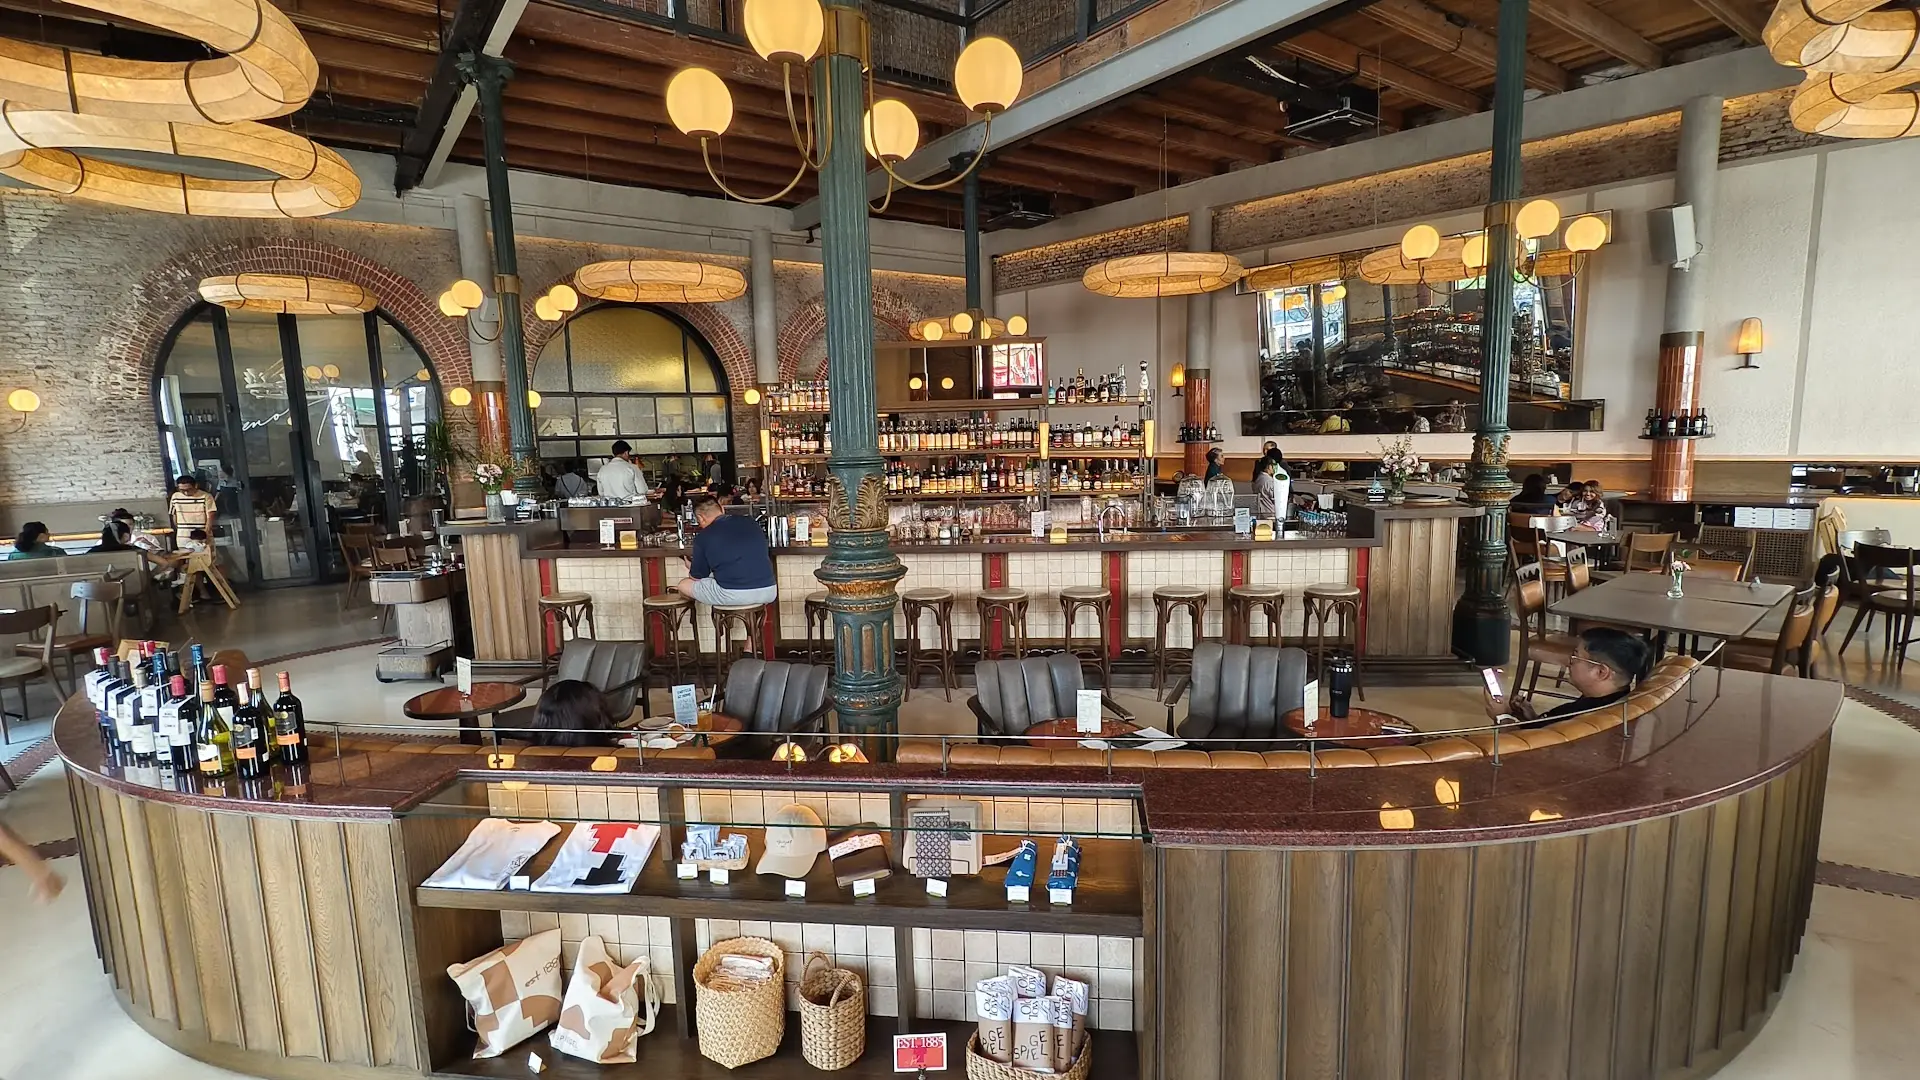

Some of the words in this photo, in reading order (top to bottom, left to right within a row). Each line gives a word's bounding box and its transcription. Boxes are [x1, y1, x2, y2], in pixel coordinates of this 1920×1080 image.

[542, 955, 559, 974] 188
[897, 1037, 918, 1048] EST.
[921, 1036, 944, 1048] 1885
[988, 1026, 1005, 1042] GE
[1029, 1030, 1047, 1046] GE
[981, 1038, 1006, 1055] PIEL
